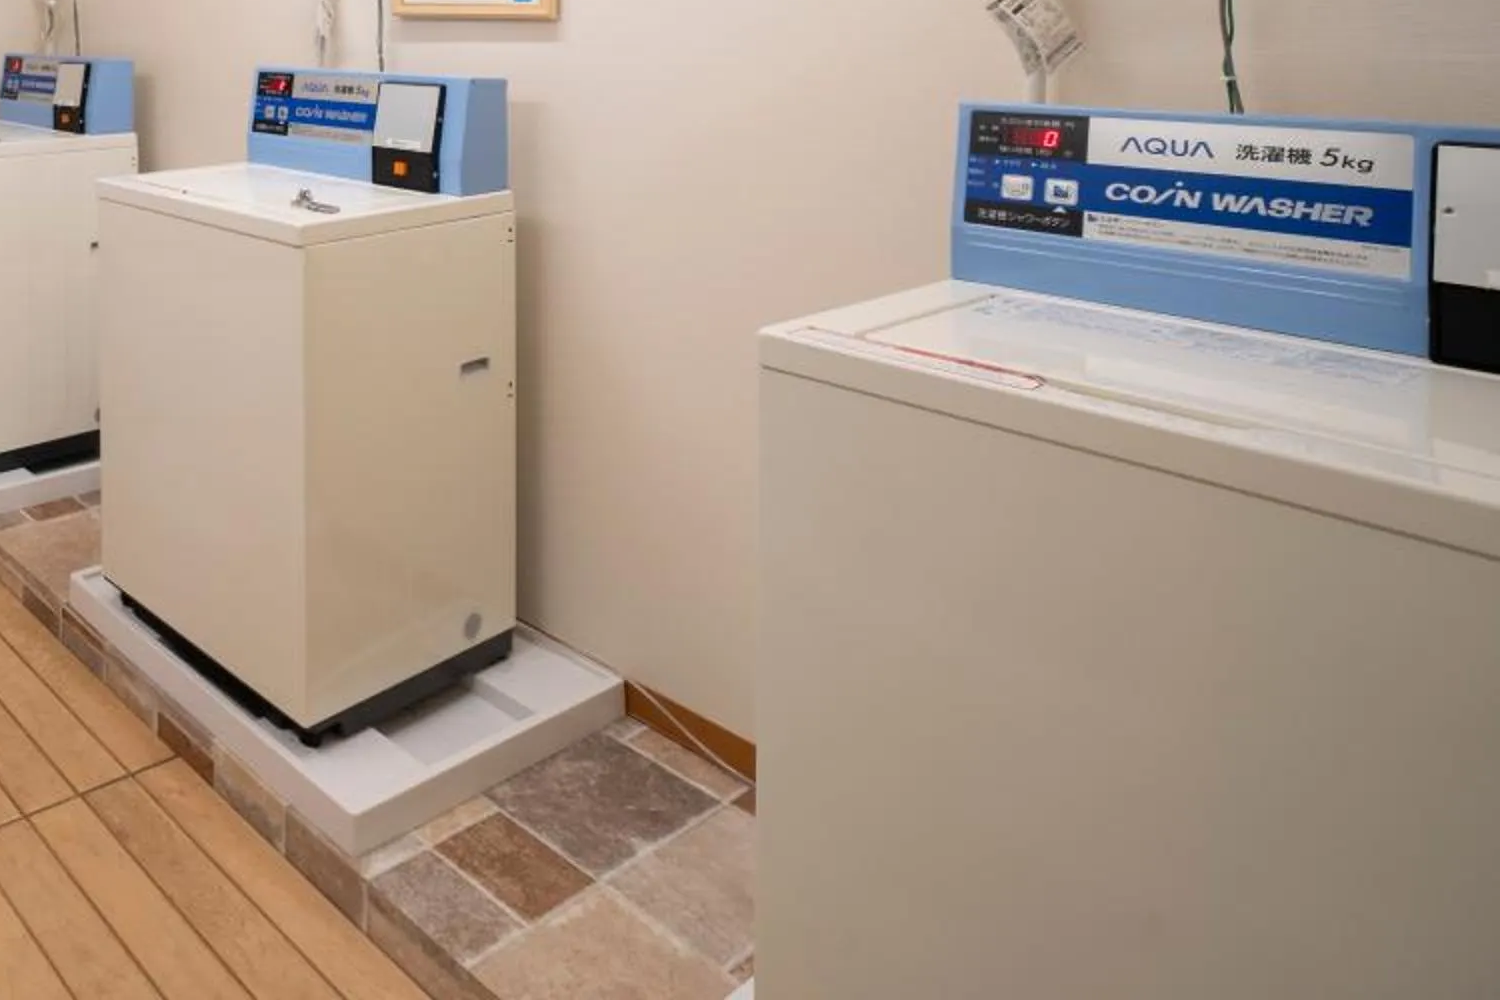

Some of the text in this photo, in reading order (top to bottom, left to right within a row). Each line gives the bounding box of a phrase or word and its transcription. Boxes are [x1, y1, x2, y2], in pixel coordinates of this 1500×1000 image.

[1043, 131, 1060, 147] 0
[1120, 136, 1215, 159] AQUA
[1235, 143, 1375, 174] 洗濯機 5kg
[1211, 192, 1375, 228] WASHER
